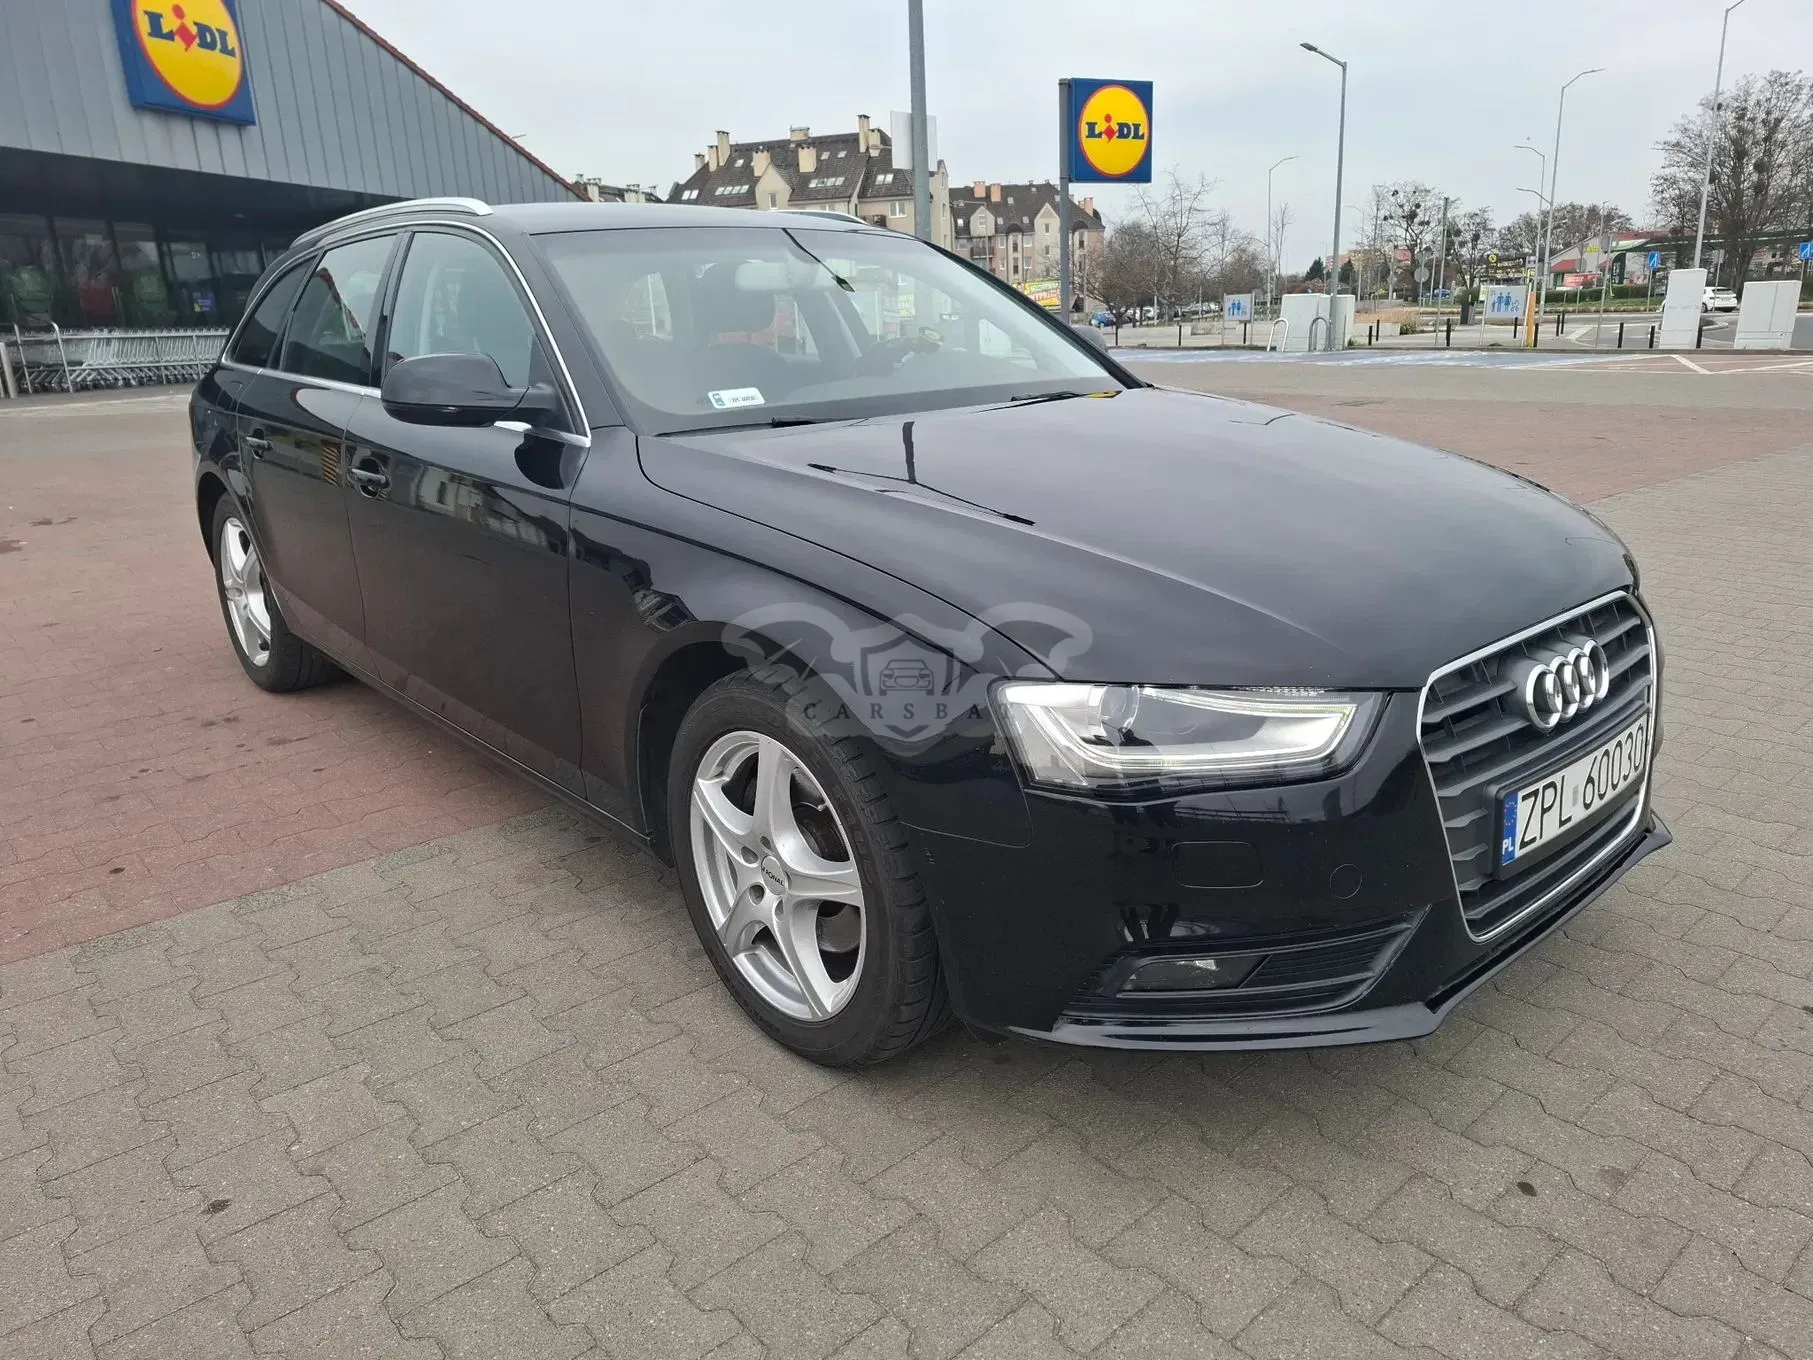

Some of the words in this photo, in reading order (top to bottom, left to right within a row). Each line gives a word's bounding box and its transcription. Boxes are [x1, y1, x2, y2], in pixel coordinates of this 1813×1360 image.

[1518, 774, 1573, 851] ZPL
[1582, 723, 1645, 811] 60030
[1502, 838, 1514, 854] PL
